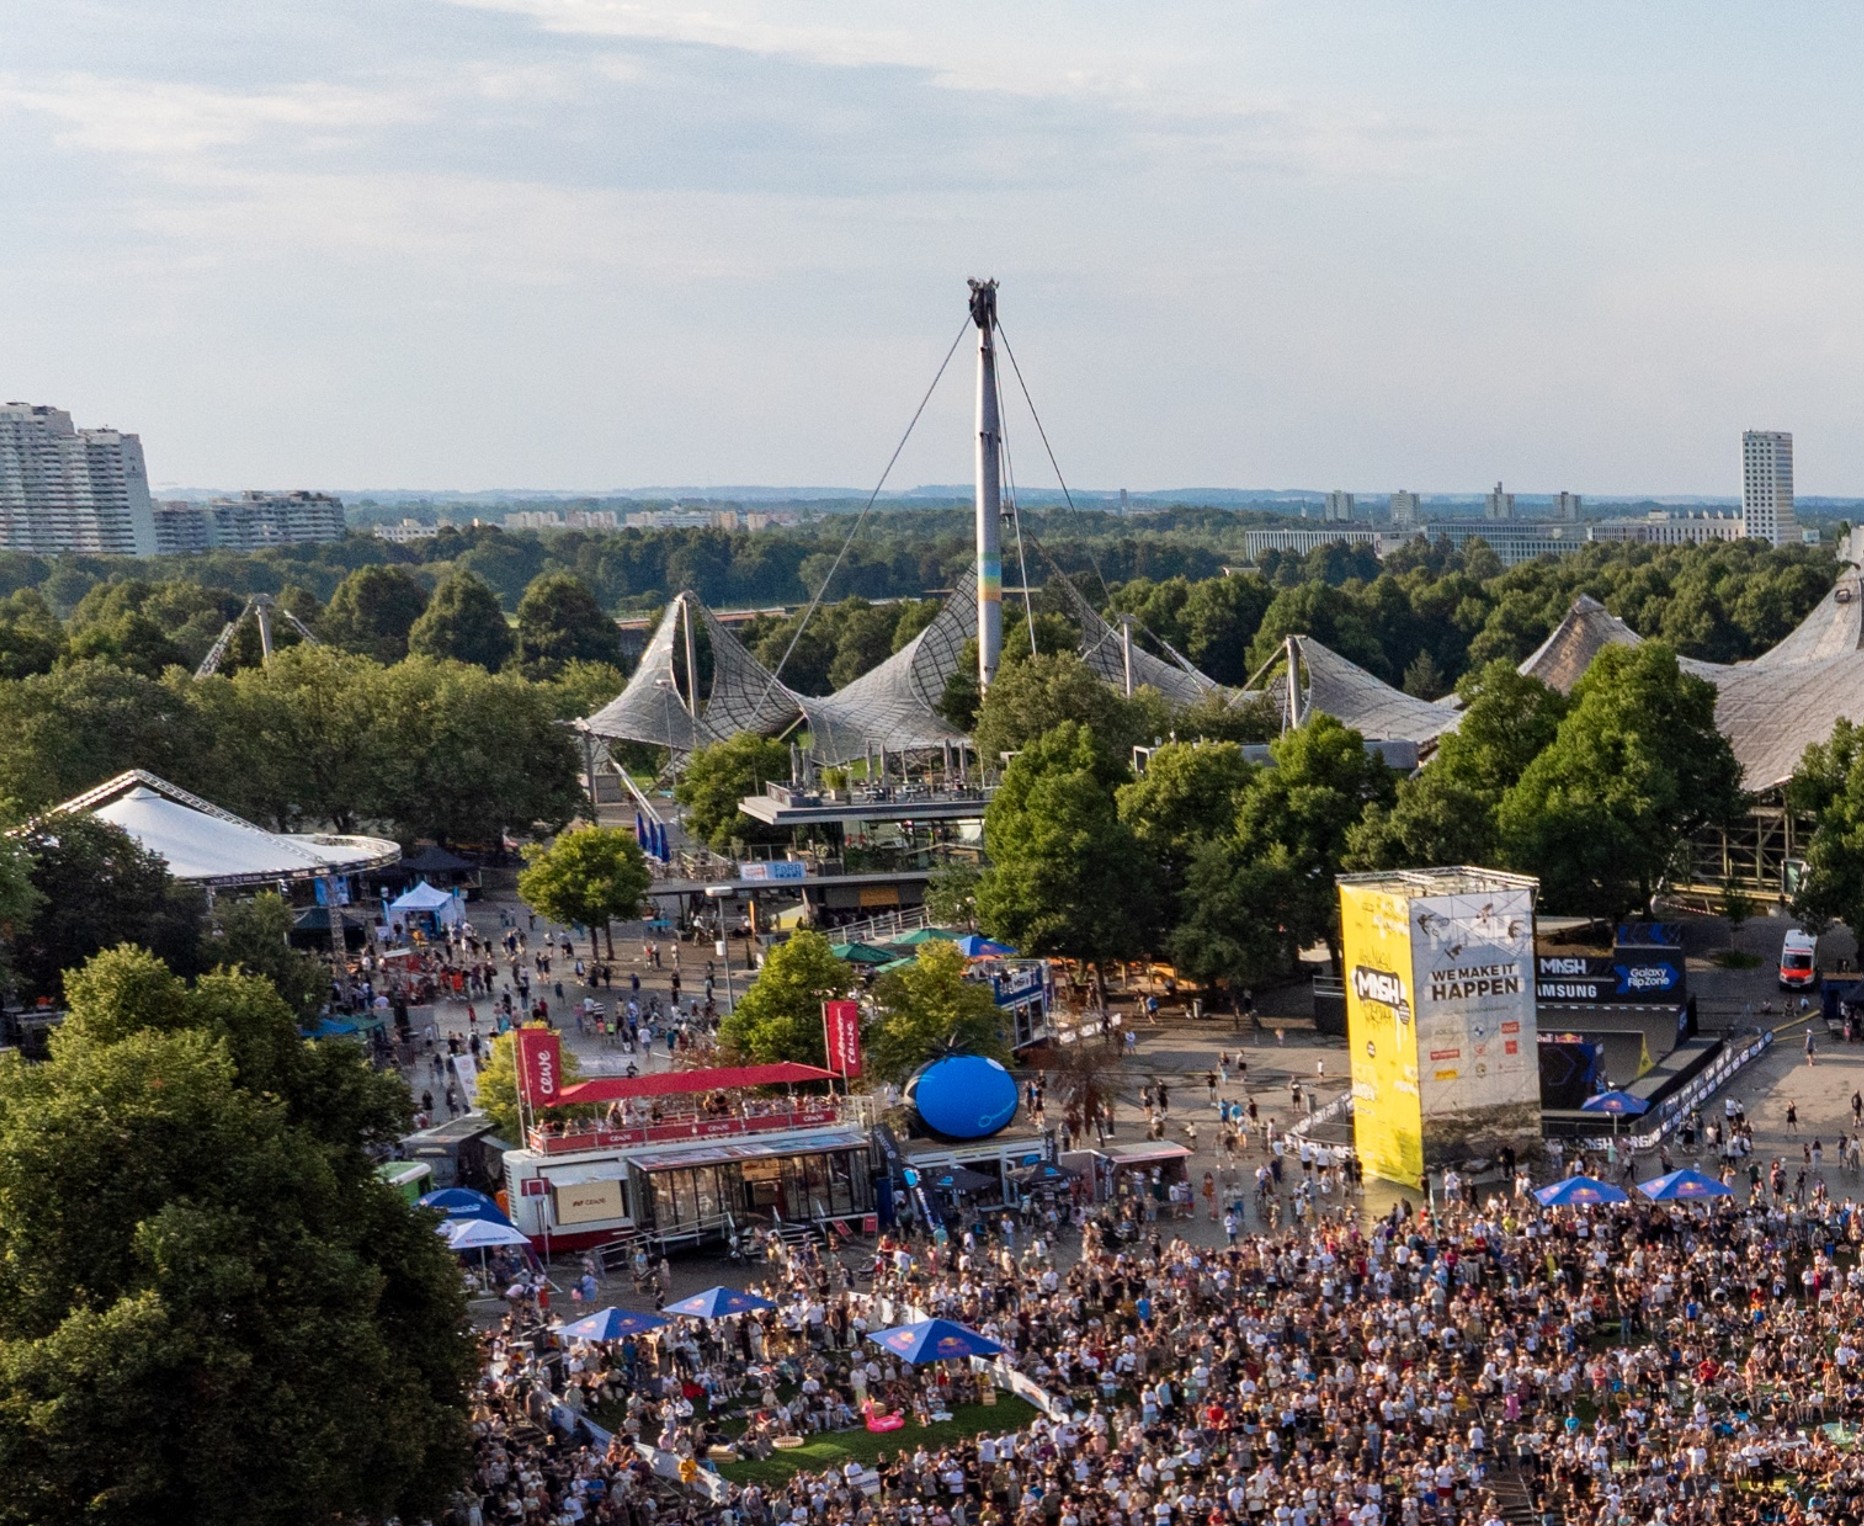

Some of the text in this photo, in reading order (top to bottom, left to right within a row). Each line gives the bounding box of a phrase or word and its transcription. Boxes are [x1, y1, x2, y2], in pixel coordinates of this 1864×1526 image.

[1431, 963, 1515, 983] WE MAKE IT
[1540, 958, 1587, 975] MASH
[1630, 967, 1668, 979] Galaxy
[1356, 971, 1400, 1005] MASH
[1431, 977, 1519, 1001] HAPPEN
[1537, 984, 1598, 998] MSUNG
[540, 1049, 552, 1095] cewe
